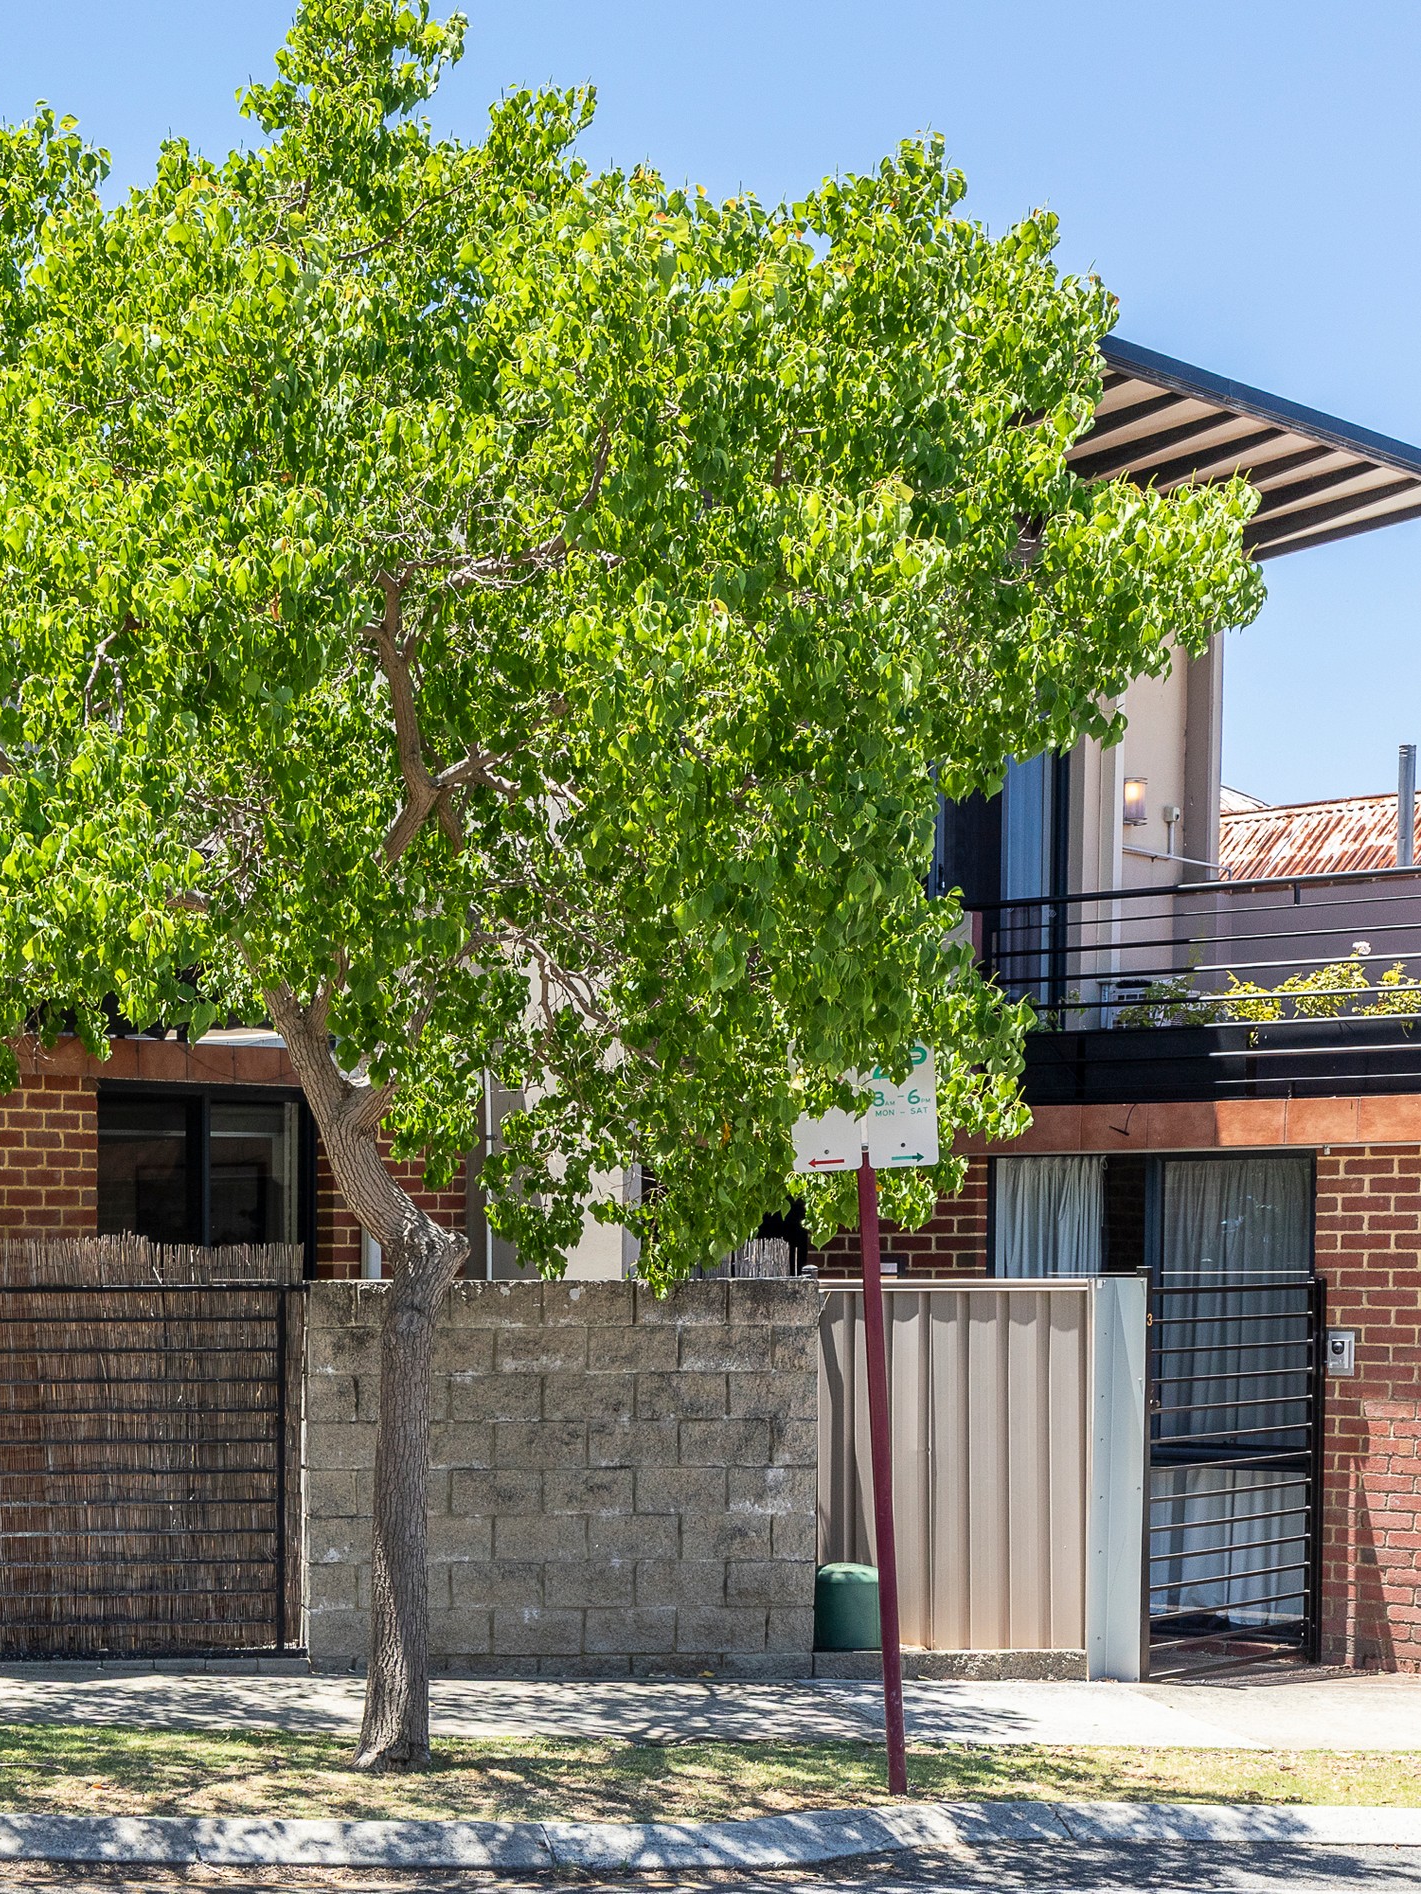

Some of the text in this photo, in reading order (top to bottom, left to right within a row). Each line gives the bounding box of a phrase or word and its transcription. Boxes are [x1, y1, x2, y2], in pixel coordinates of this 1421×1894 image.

[875, 1109, 895, 1117] MON
[910, 1106, 928, 1115] SAT
[1146, 1313, 1153, 1327] 3
